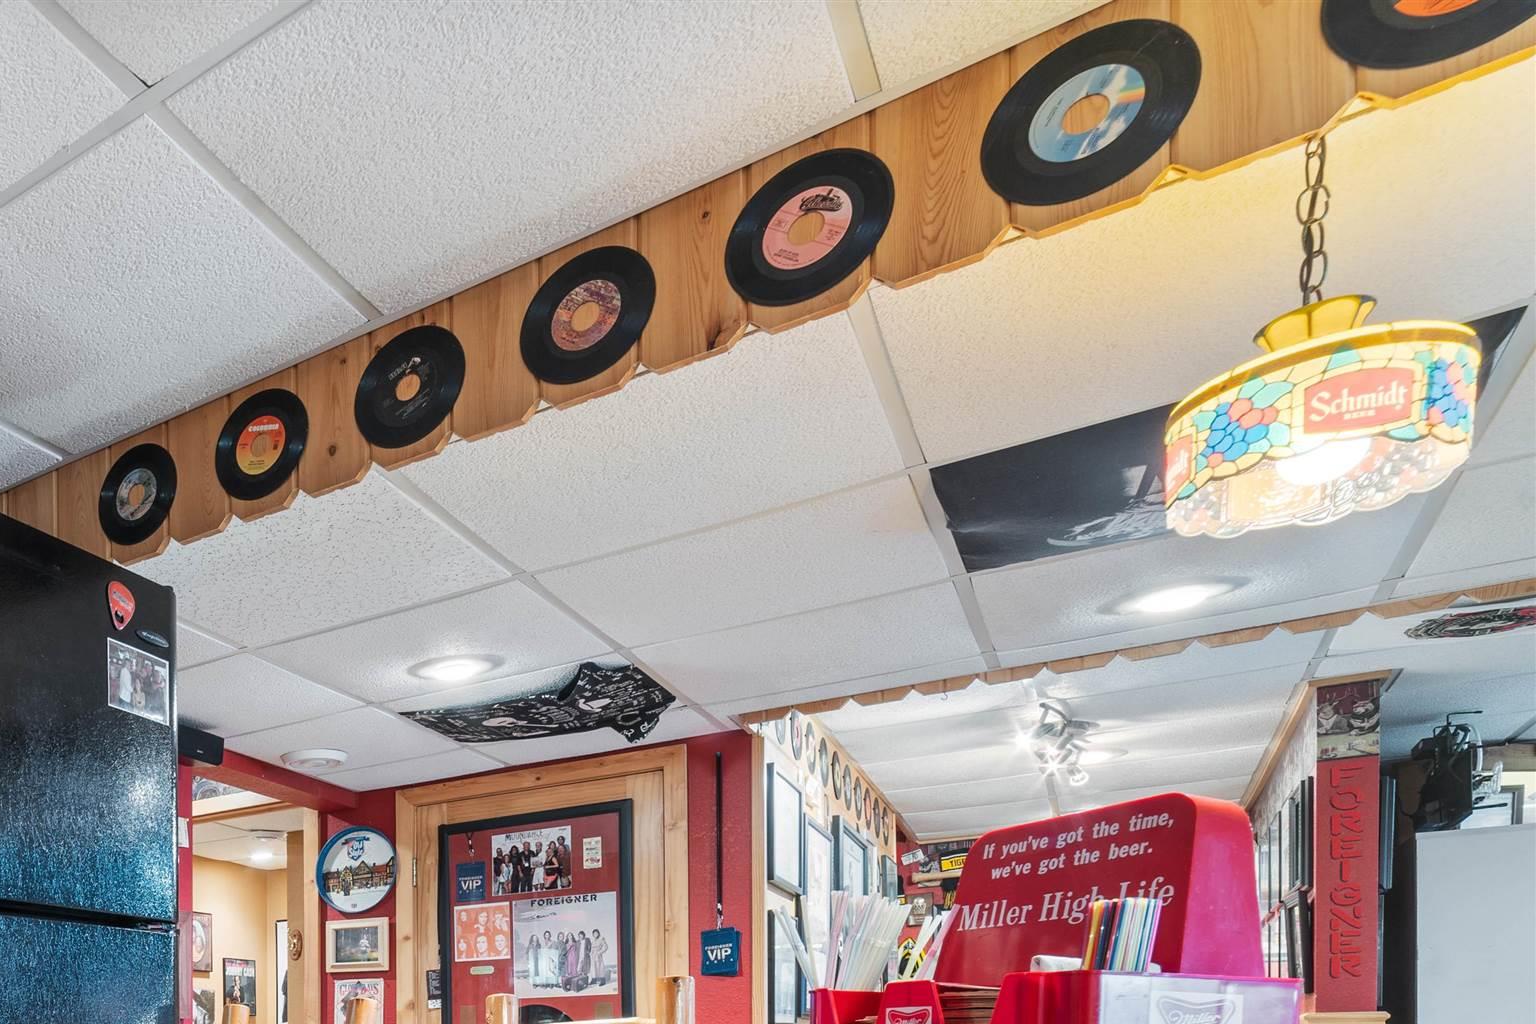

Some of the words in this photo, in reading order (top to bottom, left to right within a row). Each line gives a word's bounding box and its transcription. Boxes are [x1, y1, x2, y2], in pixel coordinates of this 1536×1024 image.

[1309, 380, 1408, 421] Schmidt
[983, 843, 996, 860] If
[1000, 835, 1049, 859] you've
[1055, 826, 1084, 849] got
[1092, 820, 1120, 839] the
[1129, 811, 1175, 833] time,
[991, 862, 1032, 880] we've
[1037, 856, 1066, 875] got
[1073, 848, 1101, 866] the
[1108, 841, 1154, 860] beer.
[1329, 766, 1363, 979] FOREIGNER
[461, 879, 482, 890] VIP
[530, 893, 598, 908] FOREIGNER
[957, 899, 1033, 932] Miller
[1038, 885, 1105, 926] High
[707, 948, 732, 961] VIP
